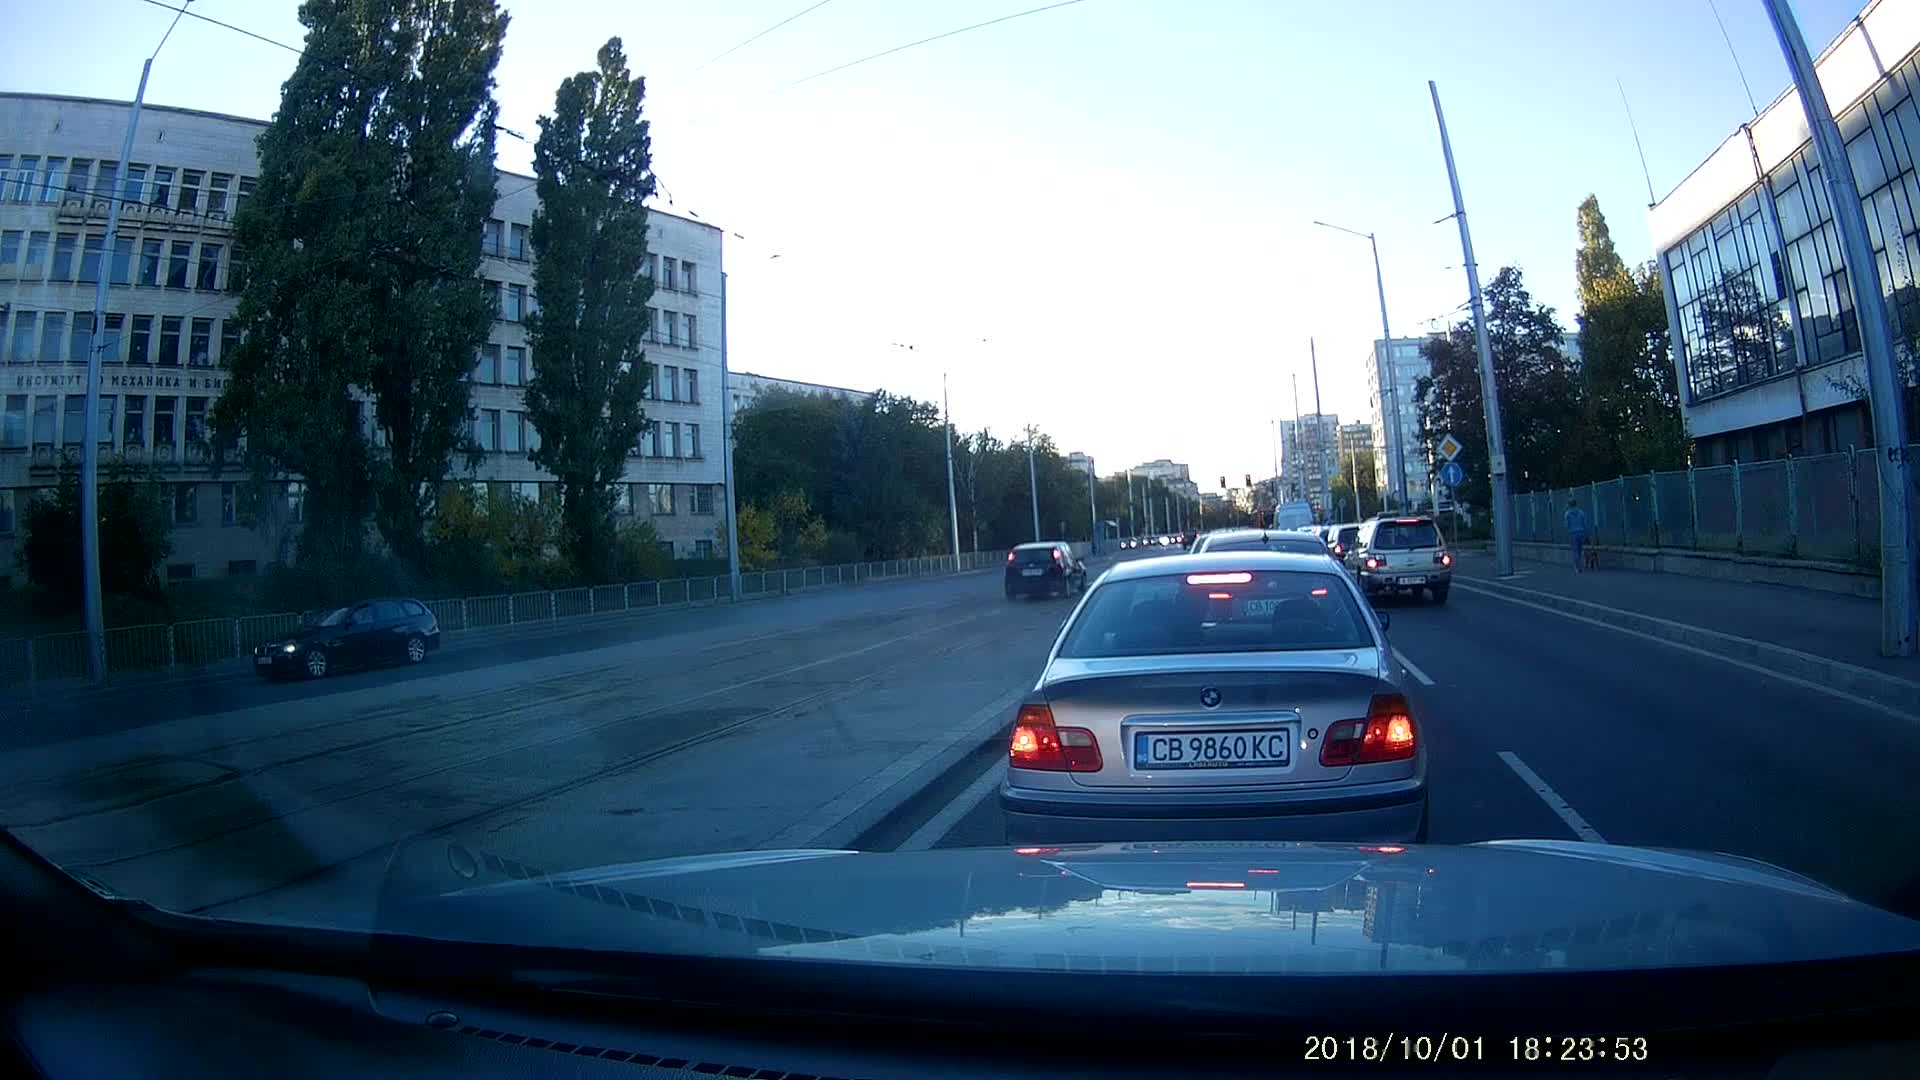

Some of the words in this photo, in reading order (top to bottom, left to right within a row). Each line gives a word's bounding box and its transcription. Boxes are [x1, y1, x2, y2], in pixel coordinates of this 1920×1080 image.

[16, 375, 81, 387] ИНСТИТУТ
[111, 375, 181, 388] МЕХАНИКА
[189, 377, 197, 389] И
[1153, 738, 1184, 761] CB
[1189, 736, 1247, 761] 9860
[1252, 735, 1283, 759] KC
